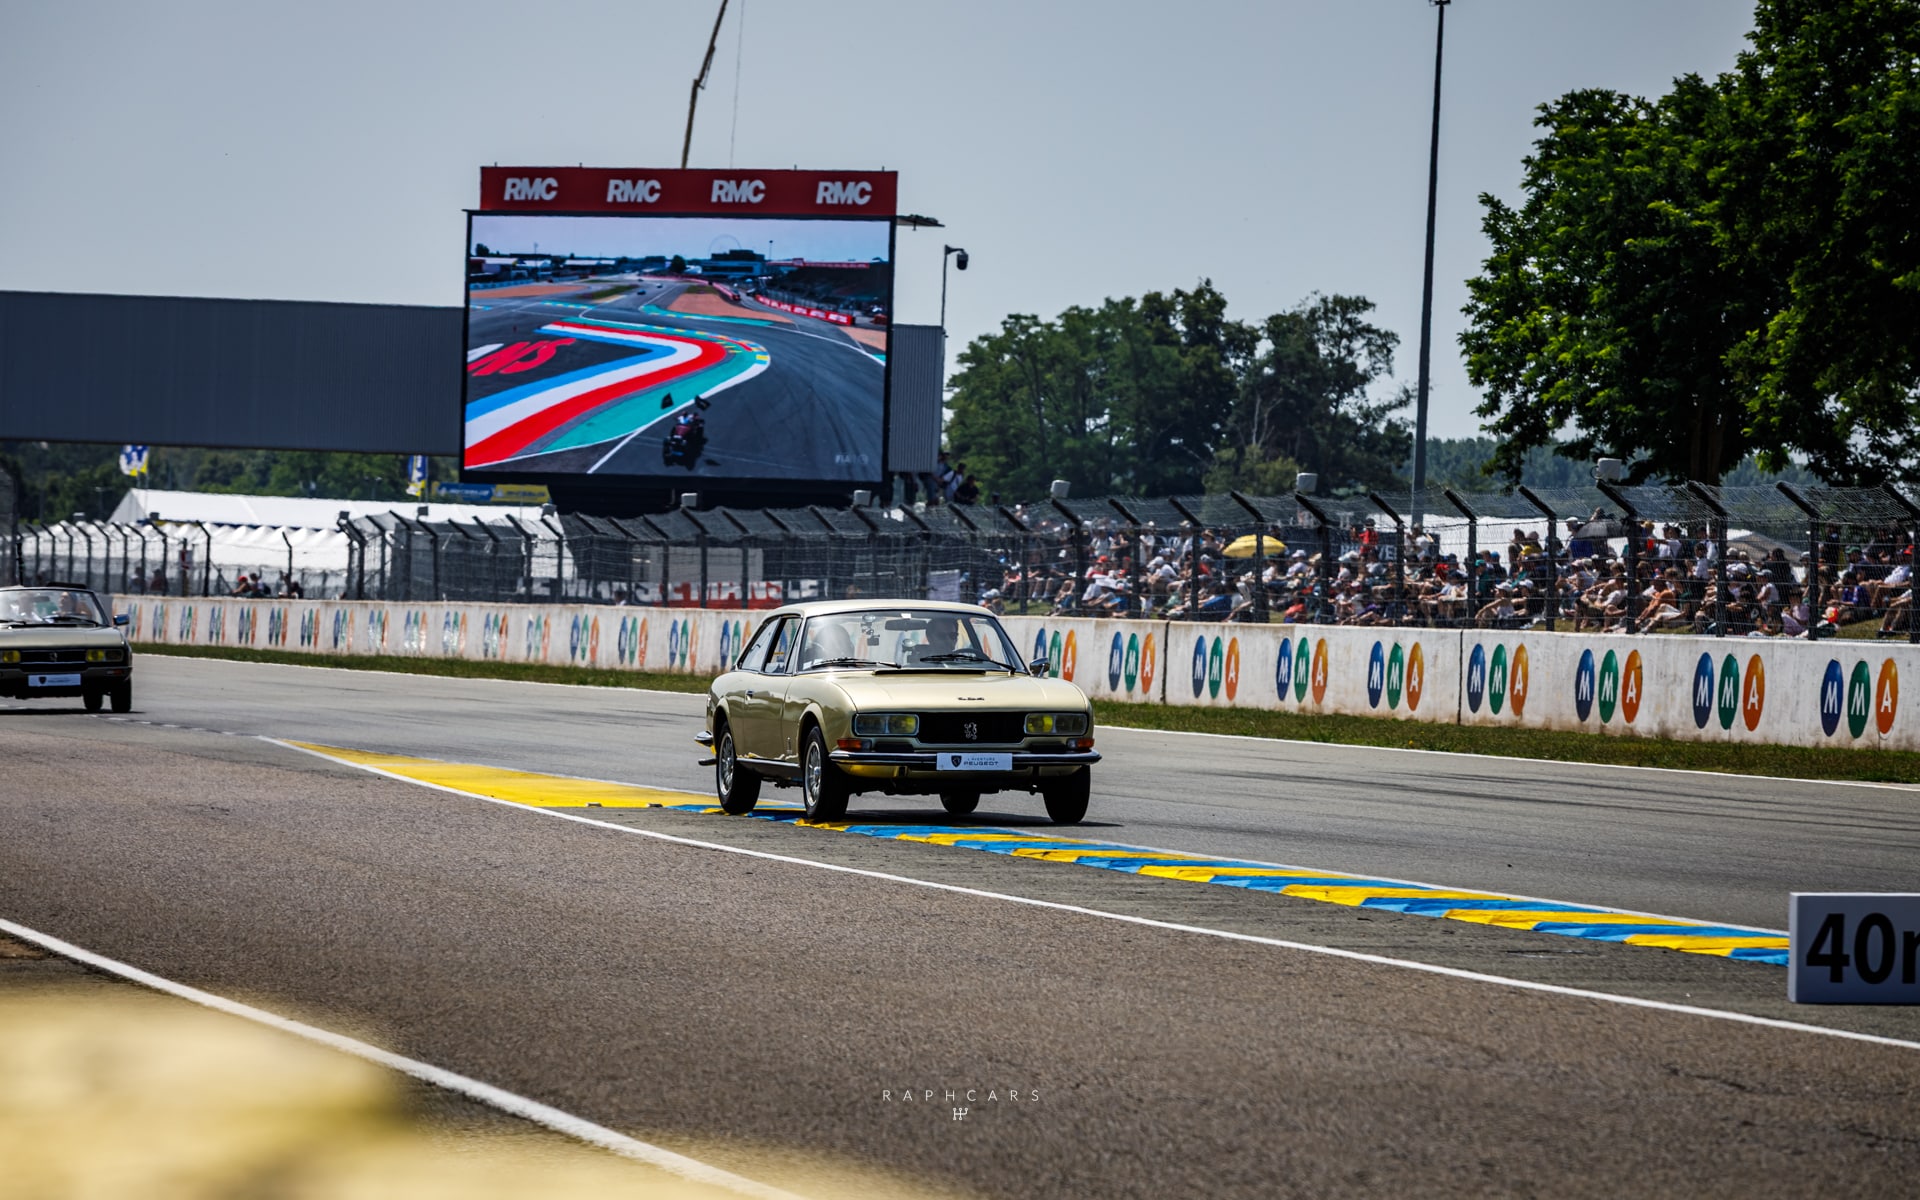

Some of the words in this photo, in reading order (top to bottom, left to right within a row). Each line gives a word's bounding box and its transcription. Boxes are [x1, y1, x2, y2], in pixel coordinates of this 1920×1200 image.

[504, 177, 558, 201] RMC
[606, 179, 661, 203] RMC
[711, 179, 765, 203] RMC
[815, 181, 872, 205] RMC
